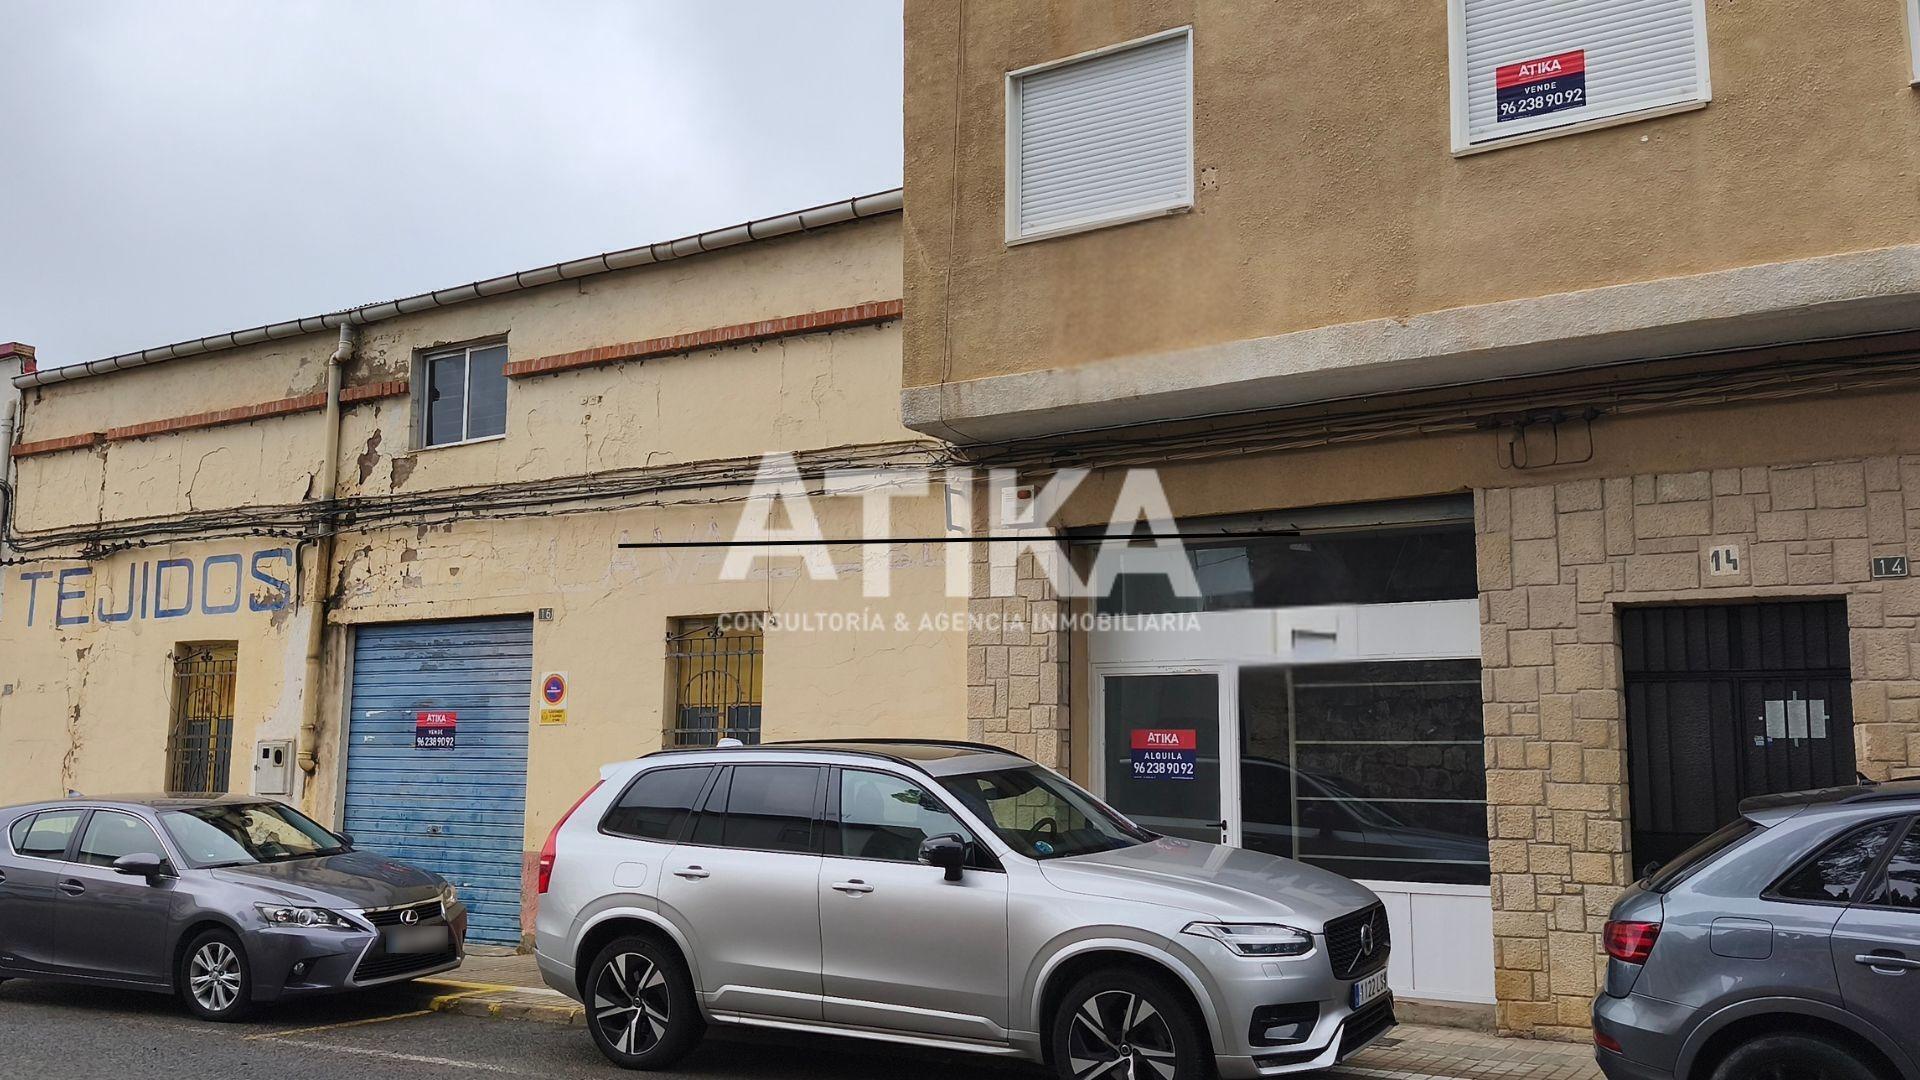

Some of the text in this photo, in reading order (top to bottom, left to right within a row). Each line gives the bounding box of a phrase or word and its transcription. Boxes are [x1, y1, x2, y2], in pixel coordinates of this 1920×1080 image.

[1518, 60, 1562, 77] ATIKA
[1524, 81, 1557, 94] VENDE
[1500, 101, 1516, 116] 96
[1518, 96, 1544, 112] 238
[1545, 92, 1563, 107] 90
[1565, 88, 1583, 103] 92
[1711, 549, 1738, 571] 14
[1880, 558, 1903, 575] 14
[20, 547, 293, 627] TEJIDOS
[541, 608, 551, 619] 16
[426, 713, 447, 723] ATIKA
[416, 736, 424, 747] 96
[437, 736, 446, 747] 90
[446, 736, 454, 747] 92
[1147, 732, 1180, 744] ATIKA
[1144, 751, 1183, 760] ALQUILA
[1133, 761, 1194, 775] 96 238 90 92
